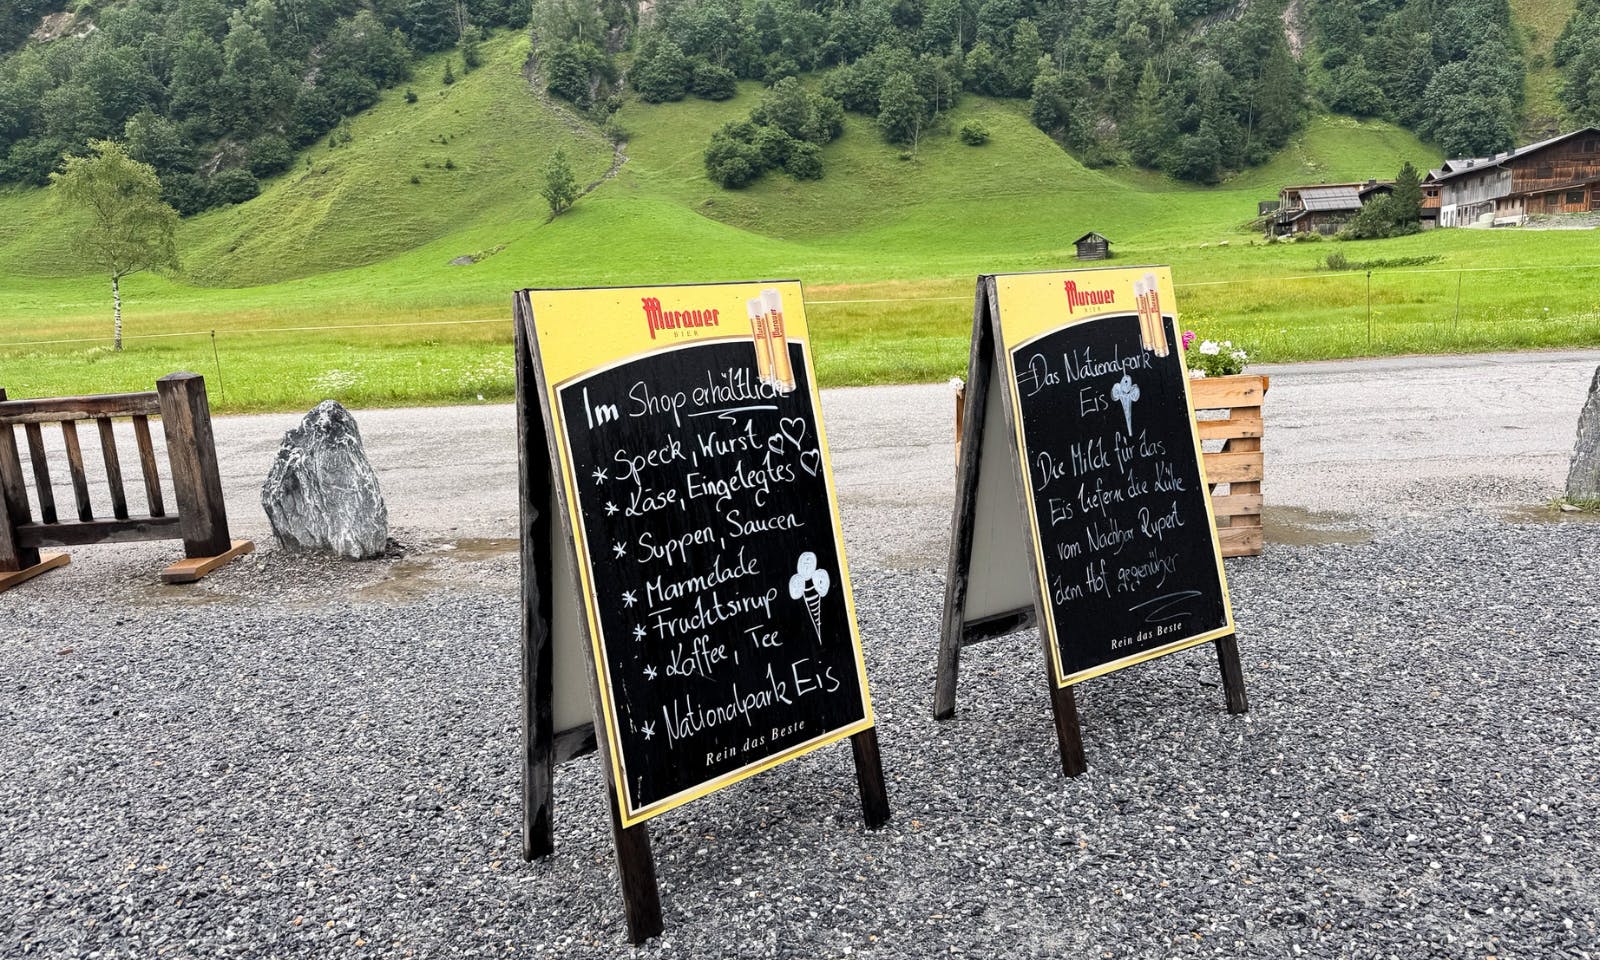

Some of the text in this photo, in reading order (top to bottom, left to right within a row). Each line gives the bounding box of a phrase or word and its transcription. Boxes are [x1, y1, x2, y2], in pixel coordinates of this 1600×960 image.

[641, 297, 720, 339] Murauer
[1064, 280, 1115, 314] Murauer
[673, 330, 699, 338] BIER
[1026, 334, 1153, 397] Das Nationalpark
[583, 364, 790, 430] Im Shop erhältlich
[1080, 386, 1109, 418] Eis
[698, 419, 763, 458] Wurst
[1037, 428, 1166, 491] Die Milch für das
[687, 451, 796, 512] Eingelegtes
[1049, 499, 1074, 527] Eis
[1128, 469, 1149, 498] die
[1154, 460, 1186, 492] Kühe
[726, 509, 805, 537] Saucen
[1087, 518, 1134, 555] Nachbar
[1138, 501, 1185, 542] Rupert
[646, 546, 760, 608] Marmelade
[1055, 548, 1180, 605] dem Hof gegenüber
[648, 588, 777, 639] Fruchtsirup
[744, 625, 783, 648] Tee
[1111, 621, 1183, 650] Rein das Beste
[663, 658, 840, 749] Nationalpark Eis
[706, 720, 805, 766] Rein das Beste
